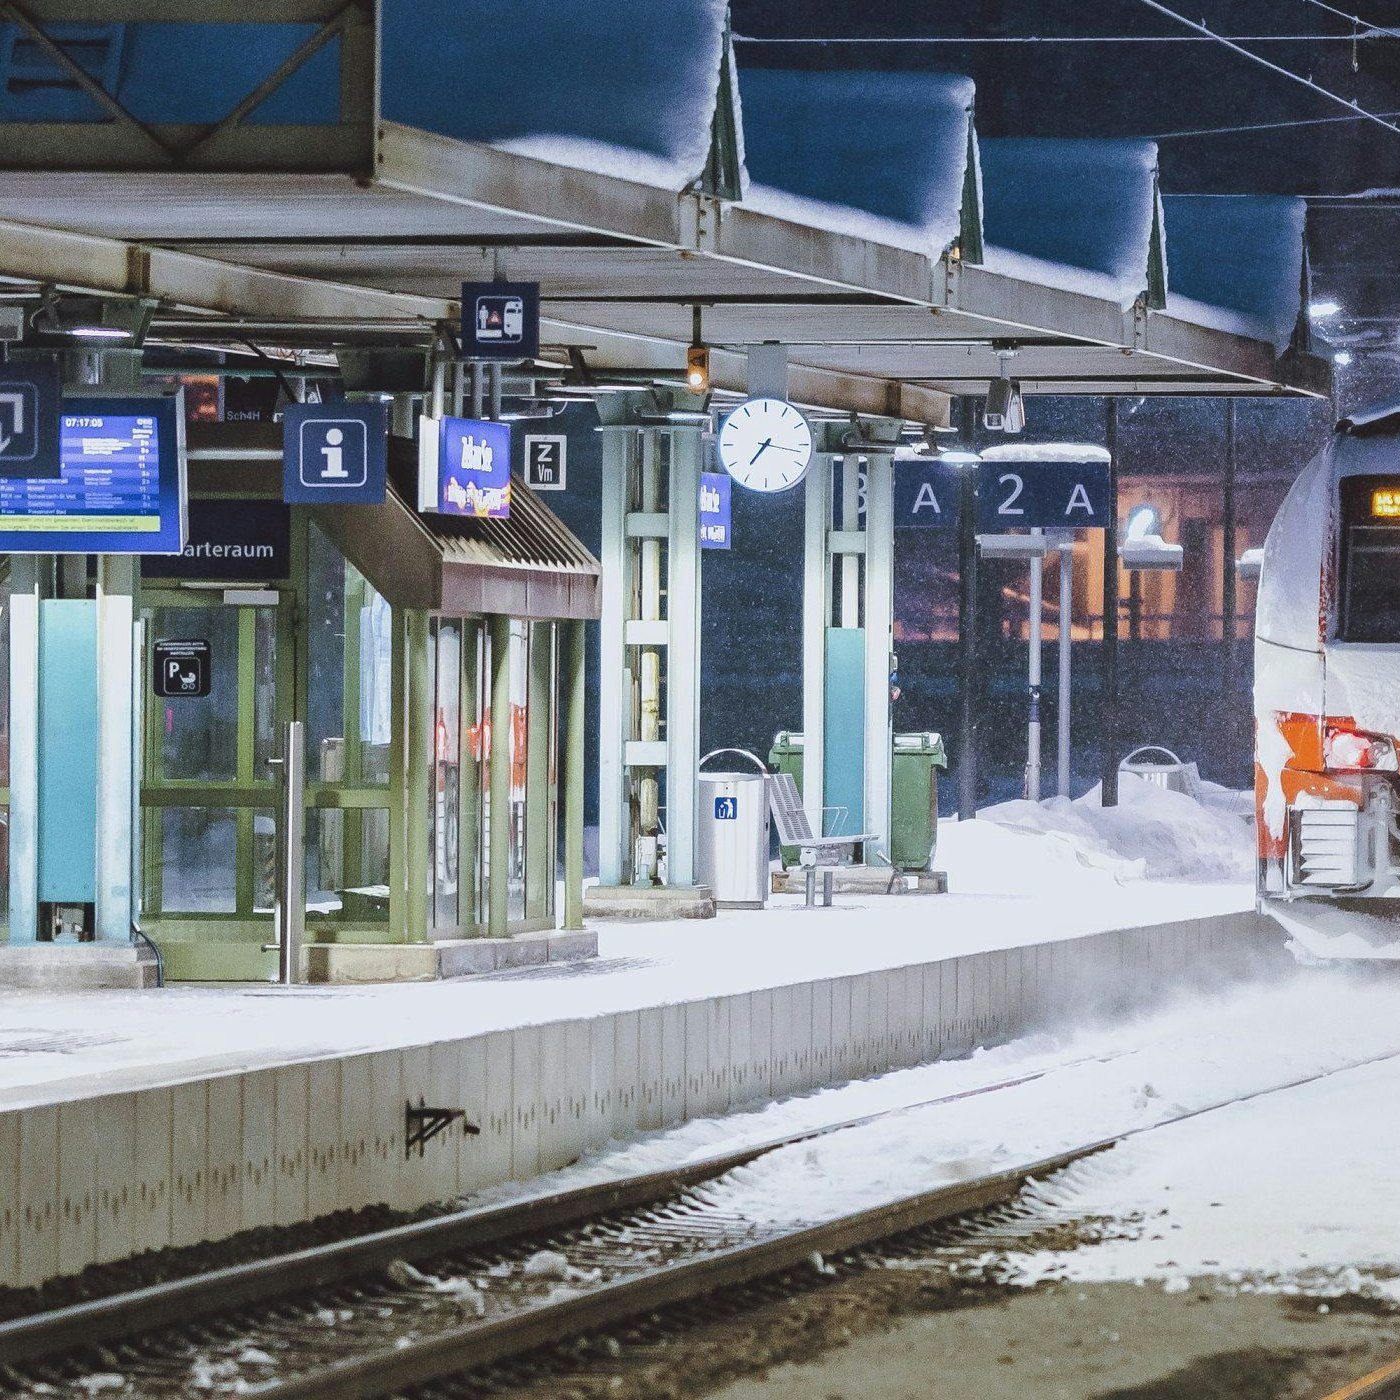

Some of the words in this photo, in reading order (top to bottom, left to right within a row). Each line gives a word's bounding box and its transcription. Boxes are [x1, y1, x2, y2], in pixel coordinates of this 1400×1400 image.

[65, 418, 104, 428] 07:17:05
[537, 444, 553, 462] Z
[537, 464, 553, 482] Vm
[911, 483, 942, 514] A
[998, 473, 1025, 515] 2
[1064, 484, 1095, 515] A
[166, 542, 274, 558] arteraum
[168, 661, 180, 679] P
